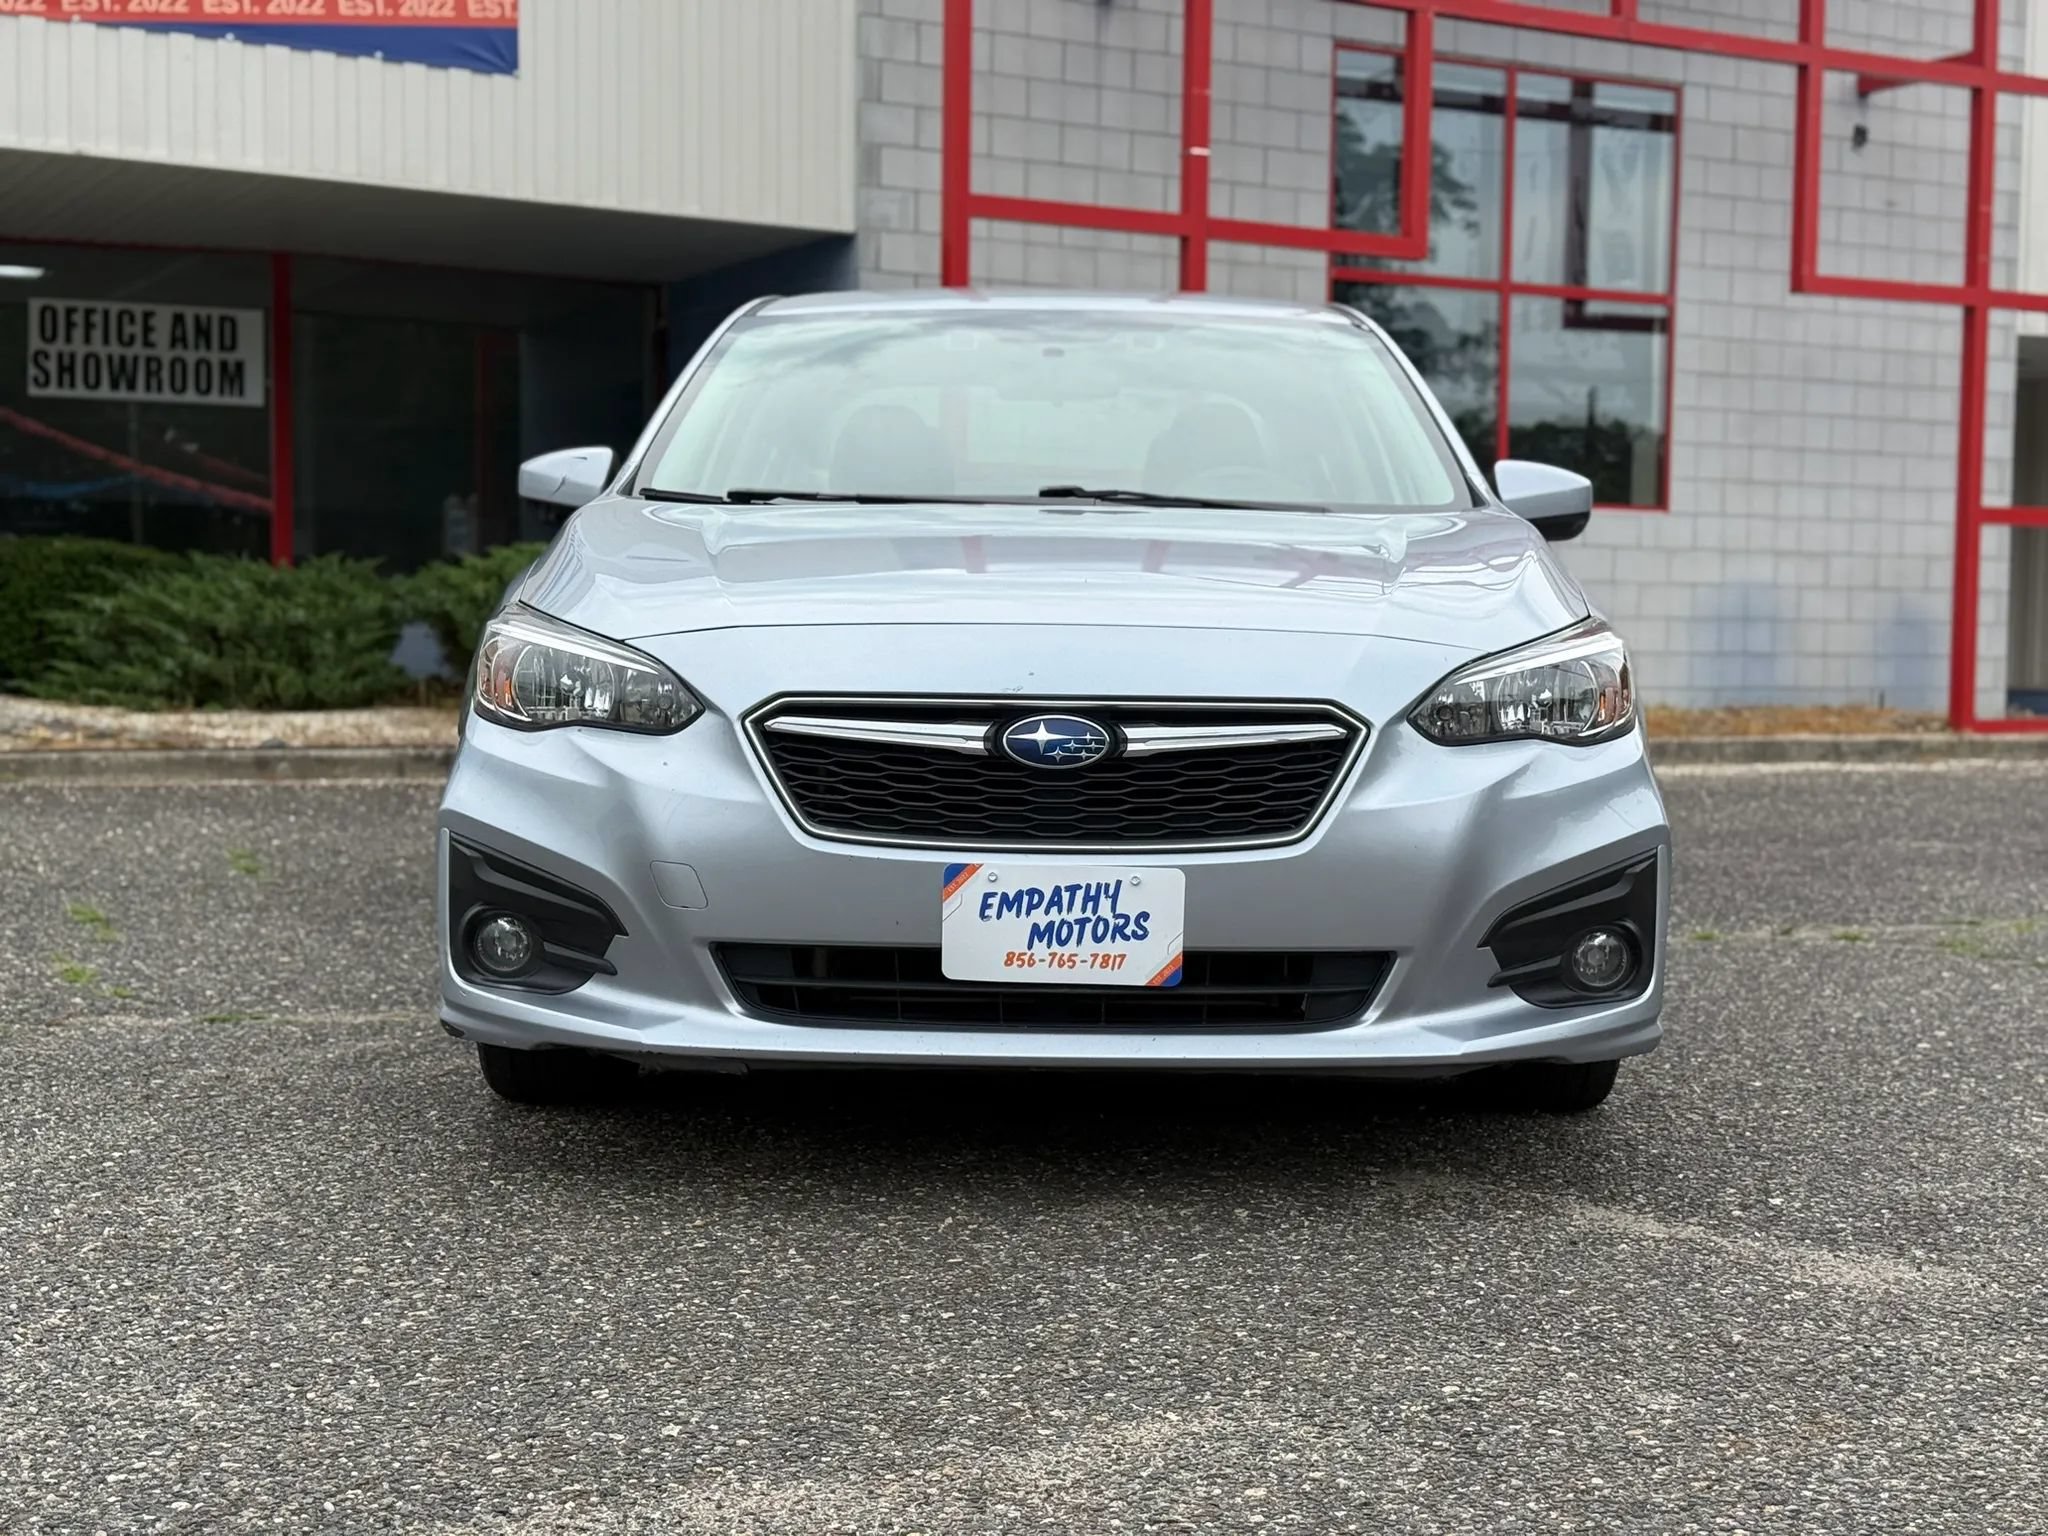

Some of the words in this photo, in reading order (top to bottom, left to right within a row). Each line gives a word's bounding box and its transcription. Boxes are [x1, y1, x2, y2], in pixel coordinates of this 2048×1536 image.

[266, 0, 326, 15] 2022
[338, 0, 394, 16] EST.
[398, 0, 456, 17] 2022
[38, 304, 157, 349] OFFICE
[169, 312, 237, 353] AND
[32, 349, 245, 397] SHOWROOM
[979, 879, 1123, 921] EMPATHY
[1027, 911, 1150, 950] MOTORS
[1003, 951, 1126, 971] 856-765-7817
